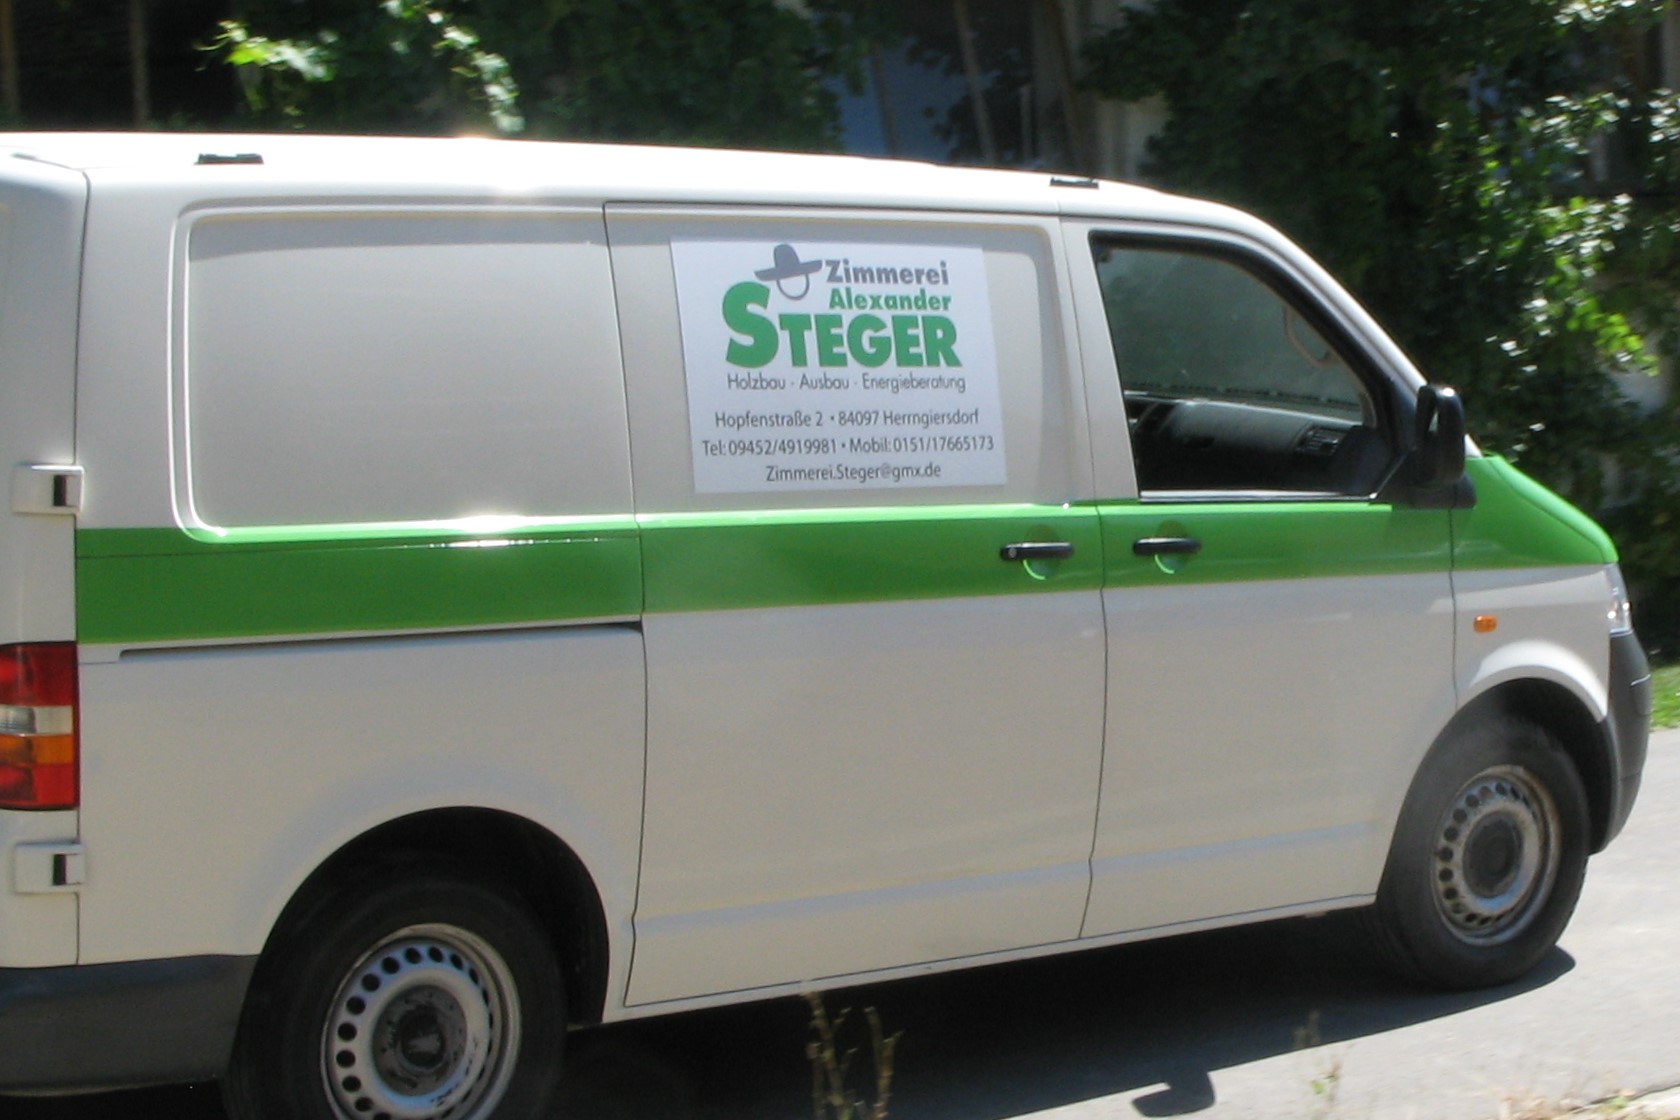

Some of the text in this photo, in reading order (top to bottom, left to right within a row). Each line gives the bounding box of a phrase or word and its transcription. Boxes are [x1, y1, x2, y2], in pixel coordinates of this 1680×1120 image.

[825, 259, 950, 285] Zimmerei
[829, 287, 952, 311] Alexander
[727, 373, 966, 393] Holzbau Ausbau Energieberatung
[715, 411, 811, 431] Hopfenstraße
[815, 411, 824, 427] 2
[838, 411, 879, 426] 84097
[766, 462, 941, 483] Zimmerei.Steger@gmx.de
